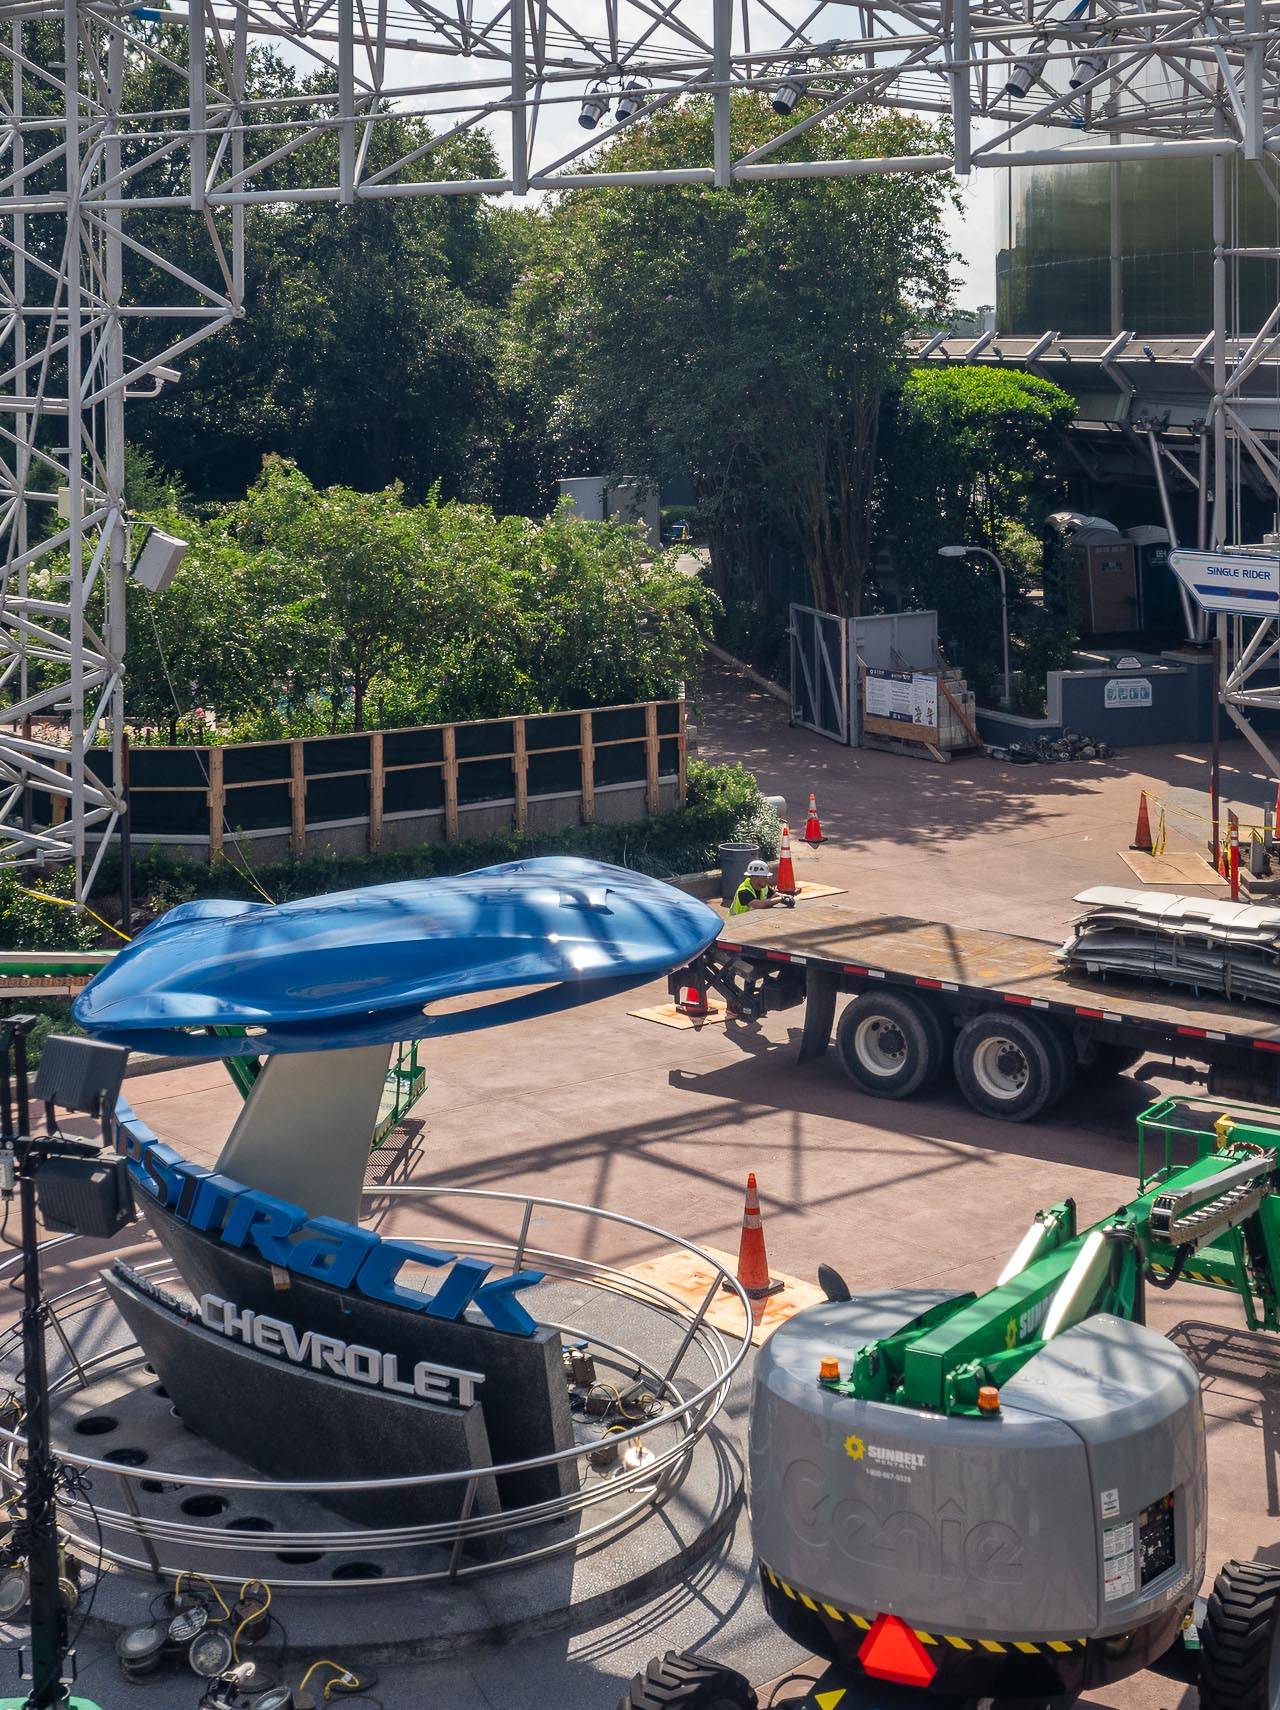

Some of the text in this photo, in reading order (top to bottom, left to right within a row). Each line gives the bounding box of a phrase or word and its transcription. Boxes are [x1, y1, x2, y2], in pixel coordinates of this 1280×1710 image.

[1207, 566, 1271, 580] SINGLE RIDER
[201, 1293, 486, 1407] CHEVROLET
[867, 1445, 926, 1467] SUNBELT
